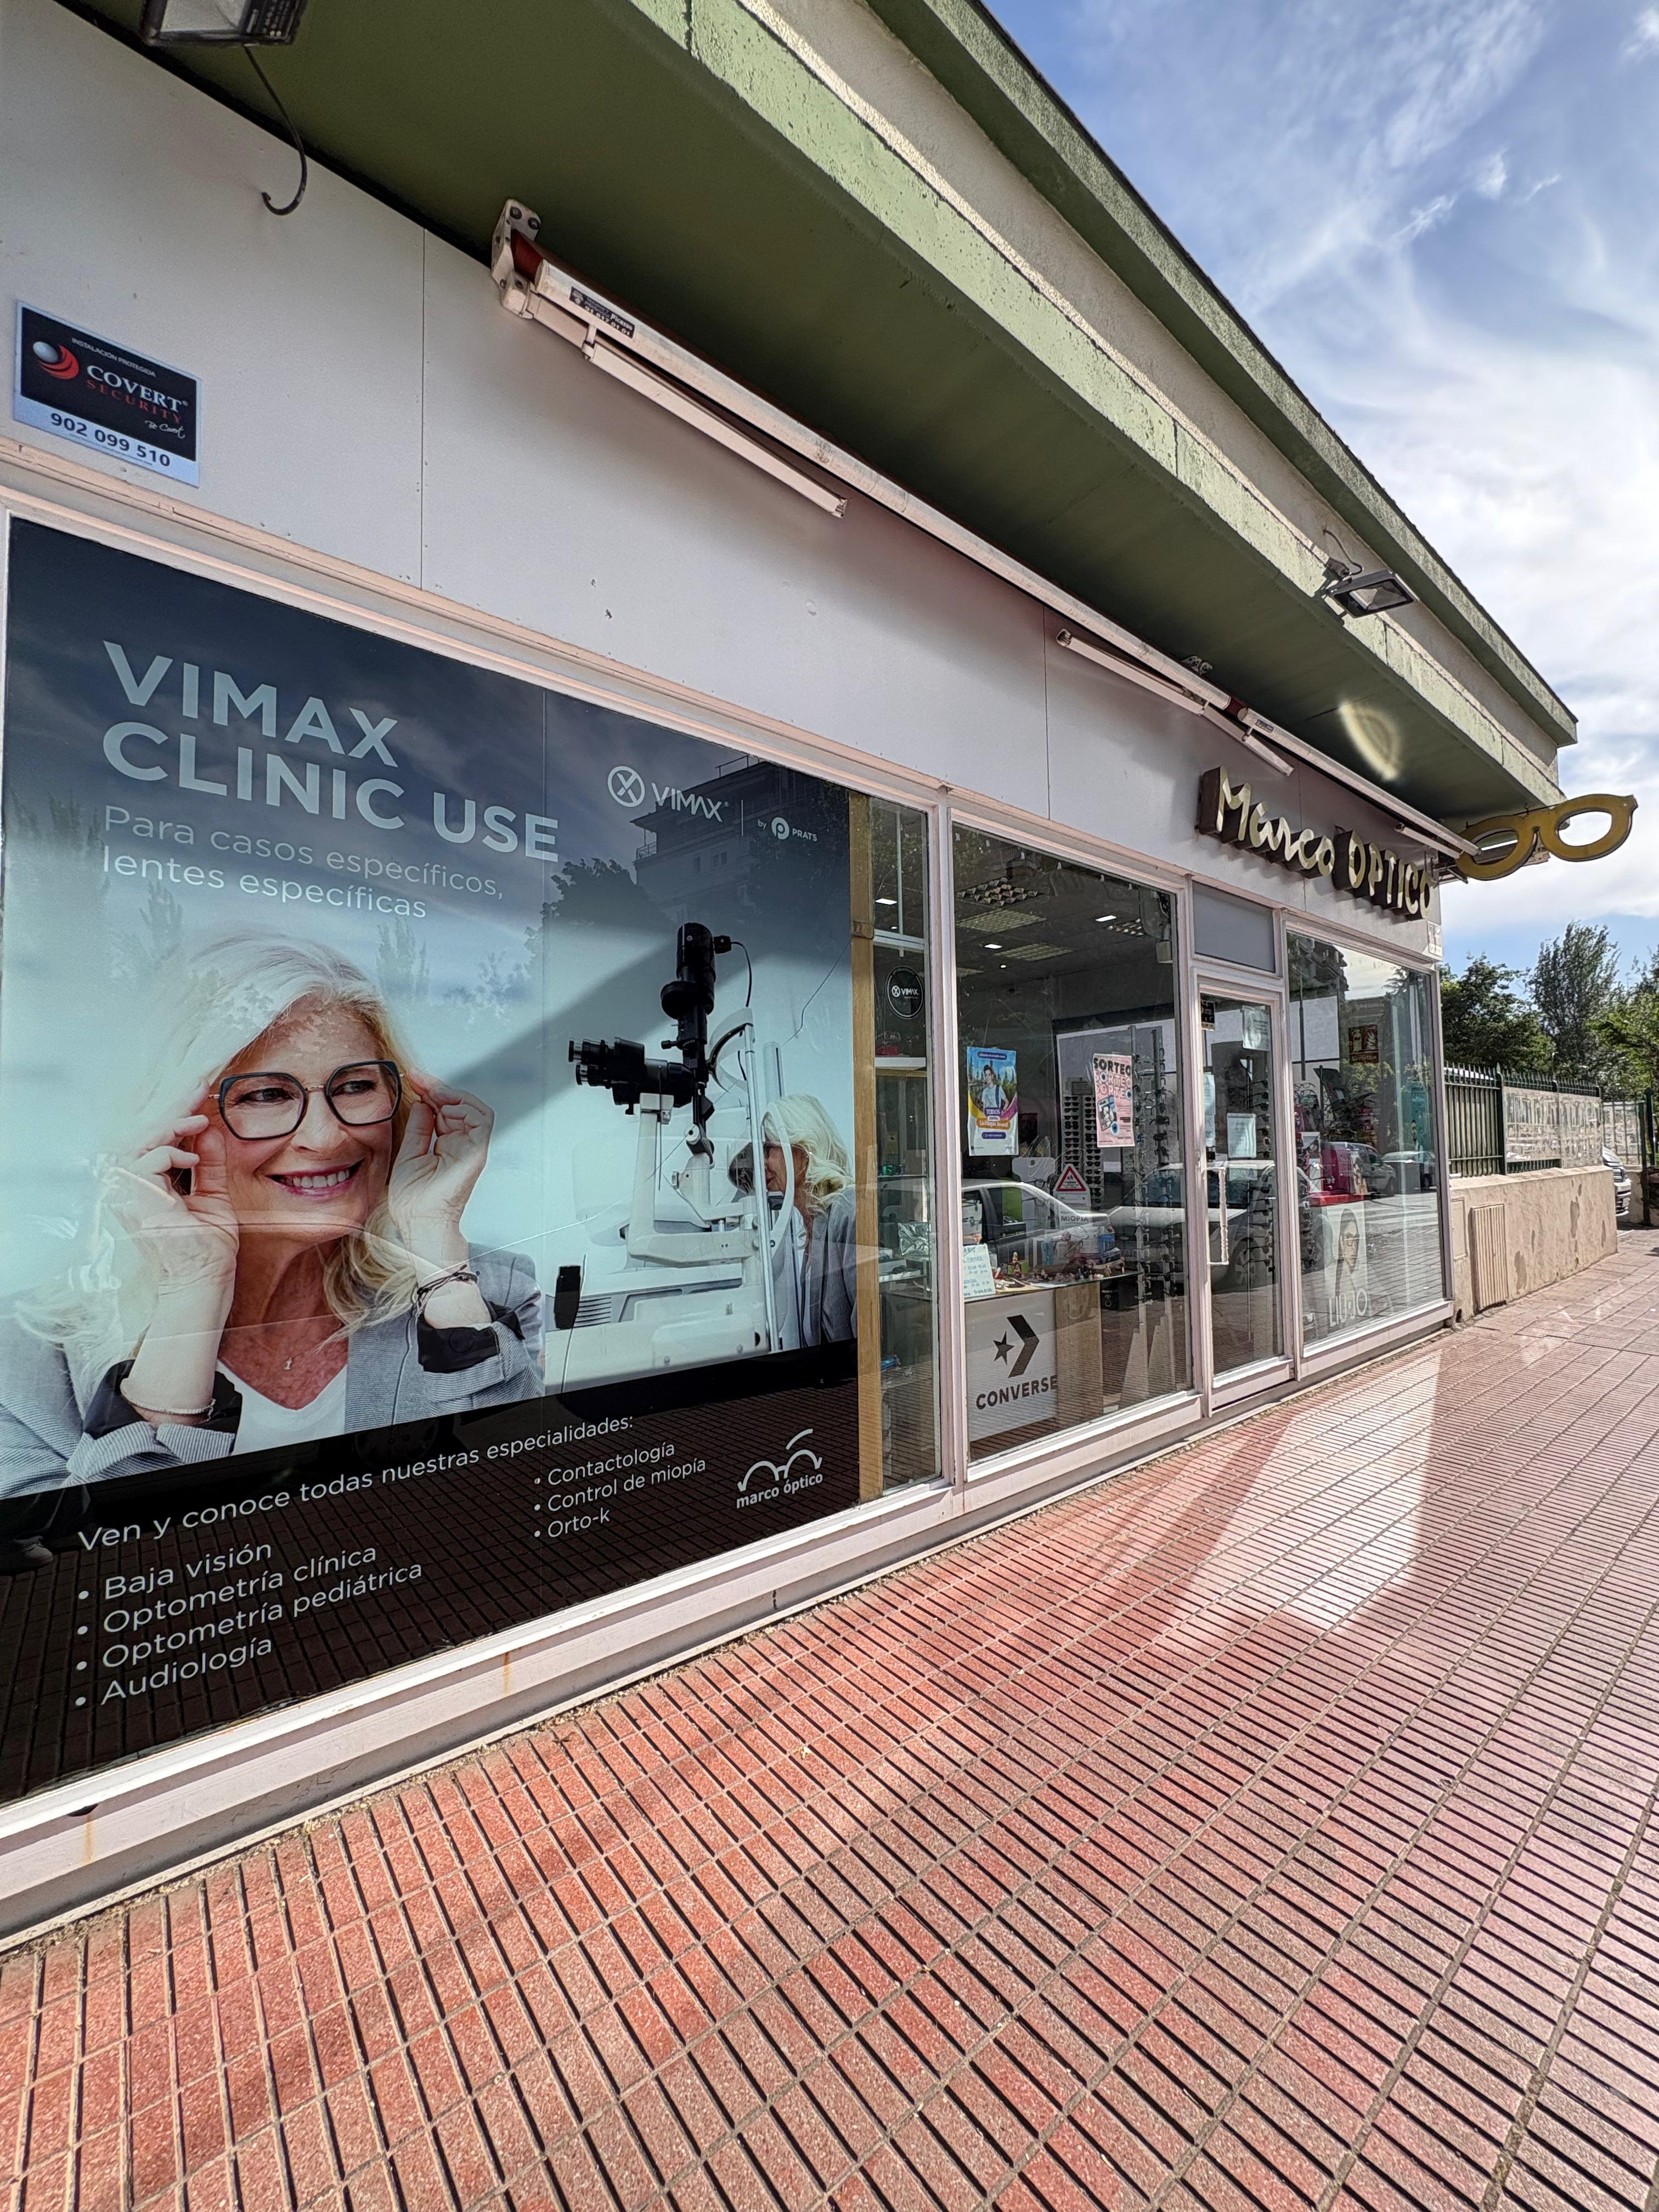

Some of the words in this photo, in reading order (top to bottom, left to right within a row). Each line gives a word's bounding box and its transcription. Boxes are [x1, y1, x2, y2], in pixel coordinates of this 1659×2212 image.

[87, 365, 182, 413] COVERT
[118, 357, 156, 377] PROTEGIDA
[86, 379, 182, 425] SECURITY
[50, 413, 88, 437] 902
[94, 429, 129, 452] 099
[136, 445, 170, 467] 510
[103, 640, 399, 768] VIMAX
[103, 721, 405, 830] CLINIC
[433, 792, 558, 862] USE
[758, 819, 766, 830] by
[792, 828, 818, 842] PRATS
[1211, 764, 1335, 878] Marco
[105, 805, 194, 845] Para
[210, 831, 314, 865] casos
[326, 850, 504, 900] específicos,
[103, 845, 225, 888] lentes
[239, 874, 426, 918] específicas
[1093, 1058, 1131, 1076] SORTEO
[976, 1375, 1058, 1410] CONVERSE
[78, 1524, 141, 1550] Ven
[153, 1517, 171, 1539] y
[182, 1491, 290, 1528] conoce
[300, 1474, 373, 1502] todas
[382, 1448, 479, 1485] nuestras
[487, 1415, 633, 1460] especialidades:
[548, 1442, 675, 1486] Contactología
[548, 1479, 618, 1513] Control
[623, 1475, 645, 1493] de
[651, 1458, 706, 1485] miopía
[736, 1487, 779, 1509] marco
[783, 1474, 823, 1494] óptico
[548, 1507, 610, 1538] Orto-k
[103, 1570, 283, 1633] Optometría
[293, 1547, 376, 1582] clínica
[105, 1568, 173, 1600] Baja
[187, 1544, 271, 1578] visión
[103, 1602, 283, 1668] Optometría
[292, 1562, 422, 1615] pediátrica
[100, 1637, 273, 1705] Audiología
